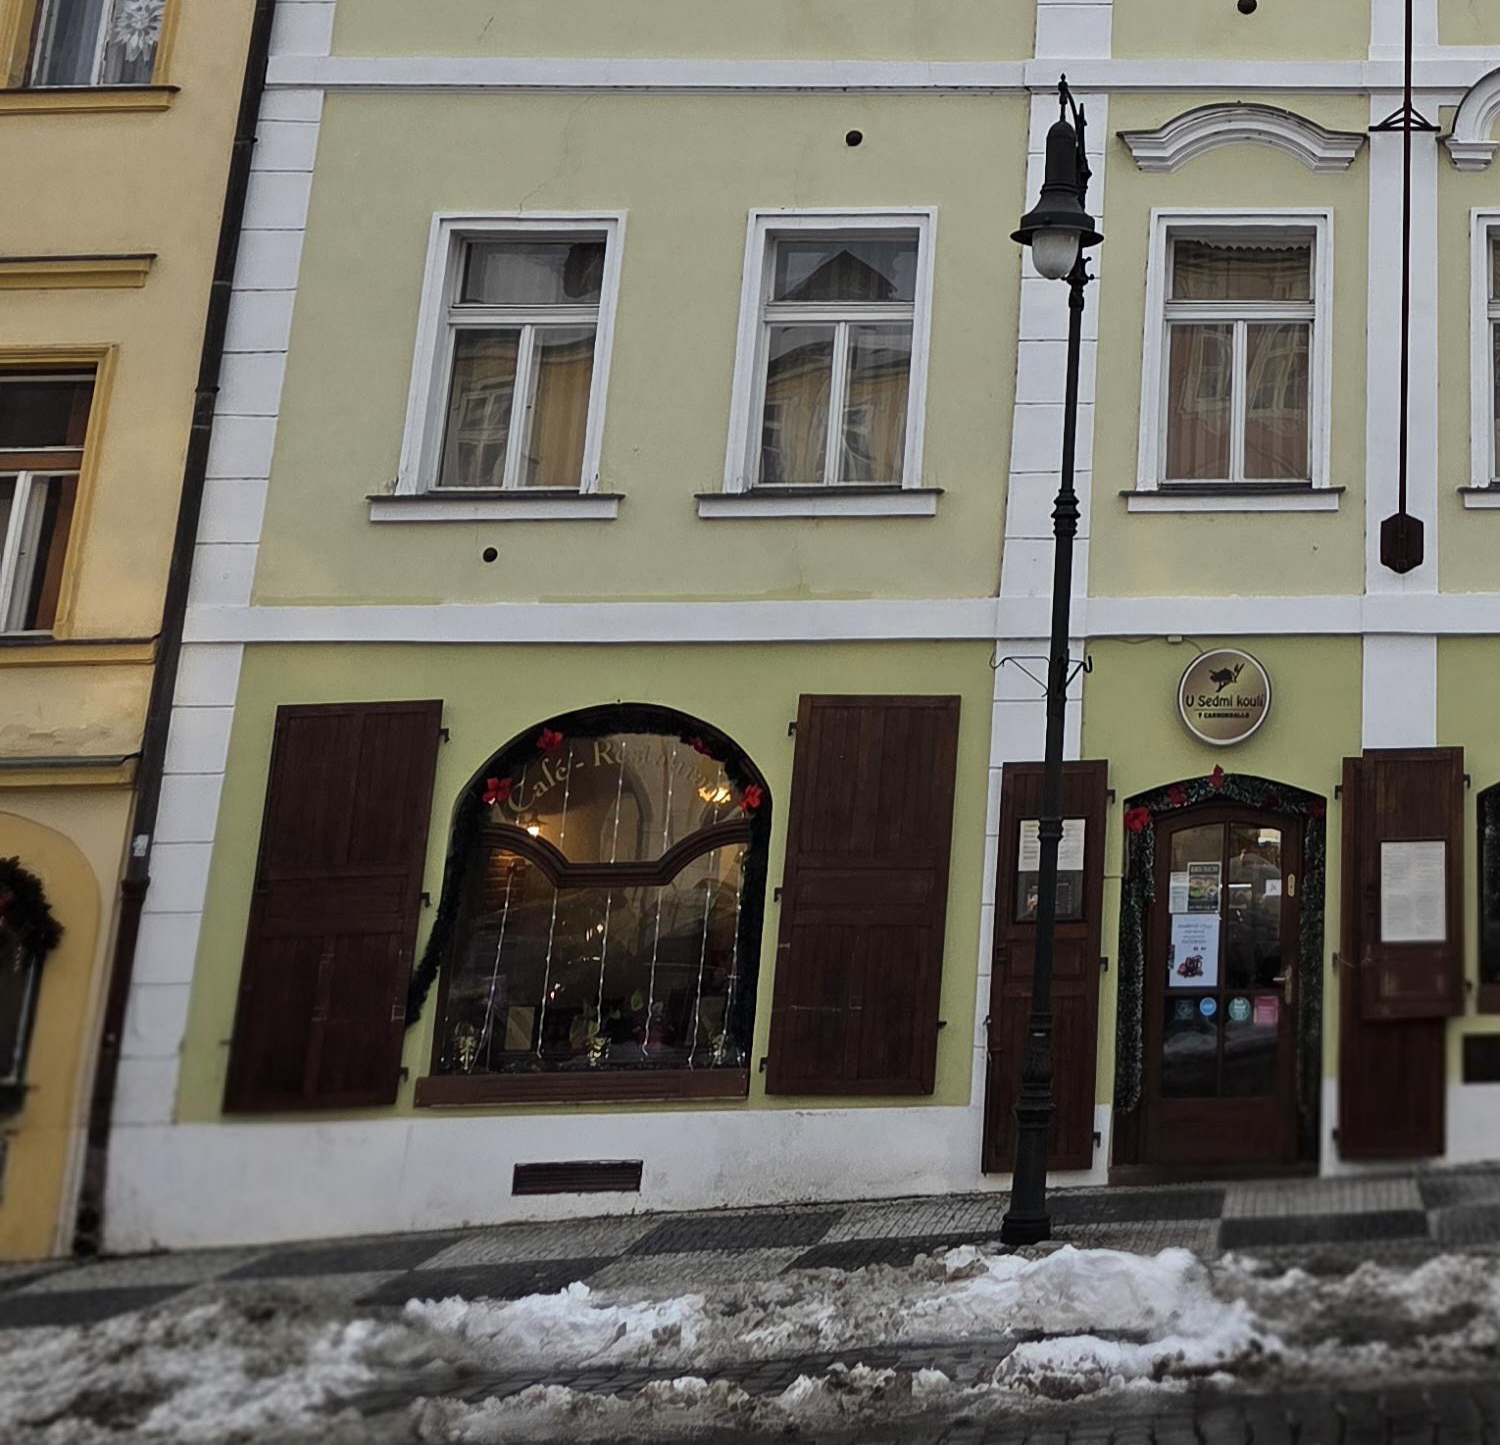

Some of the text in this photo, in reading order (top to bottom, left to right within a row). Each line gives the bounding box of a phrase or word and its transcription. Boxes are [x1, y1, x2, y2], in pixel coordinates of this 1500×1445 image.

[1186, 695, 1195, 707] U
[1198, 695, 1233, 707] Sedmi
[507, 755, 570, 812] Café
